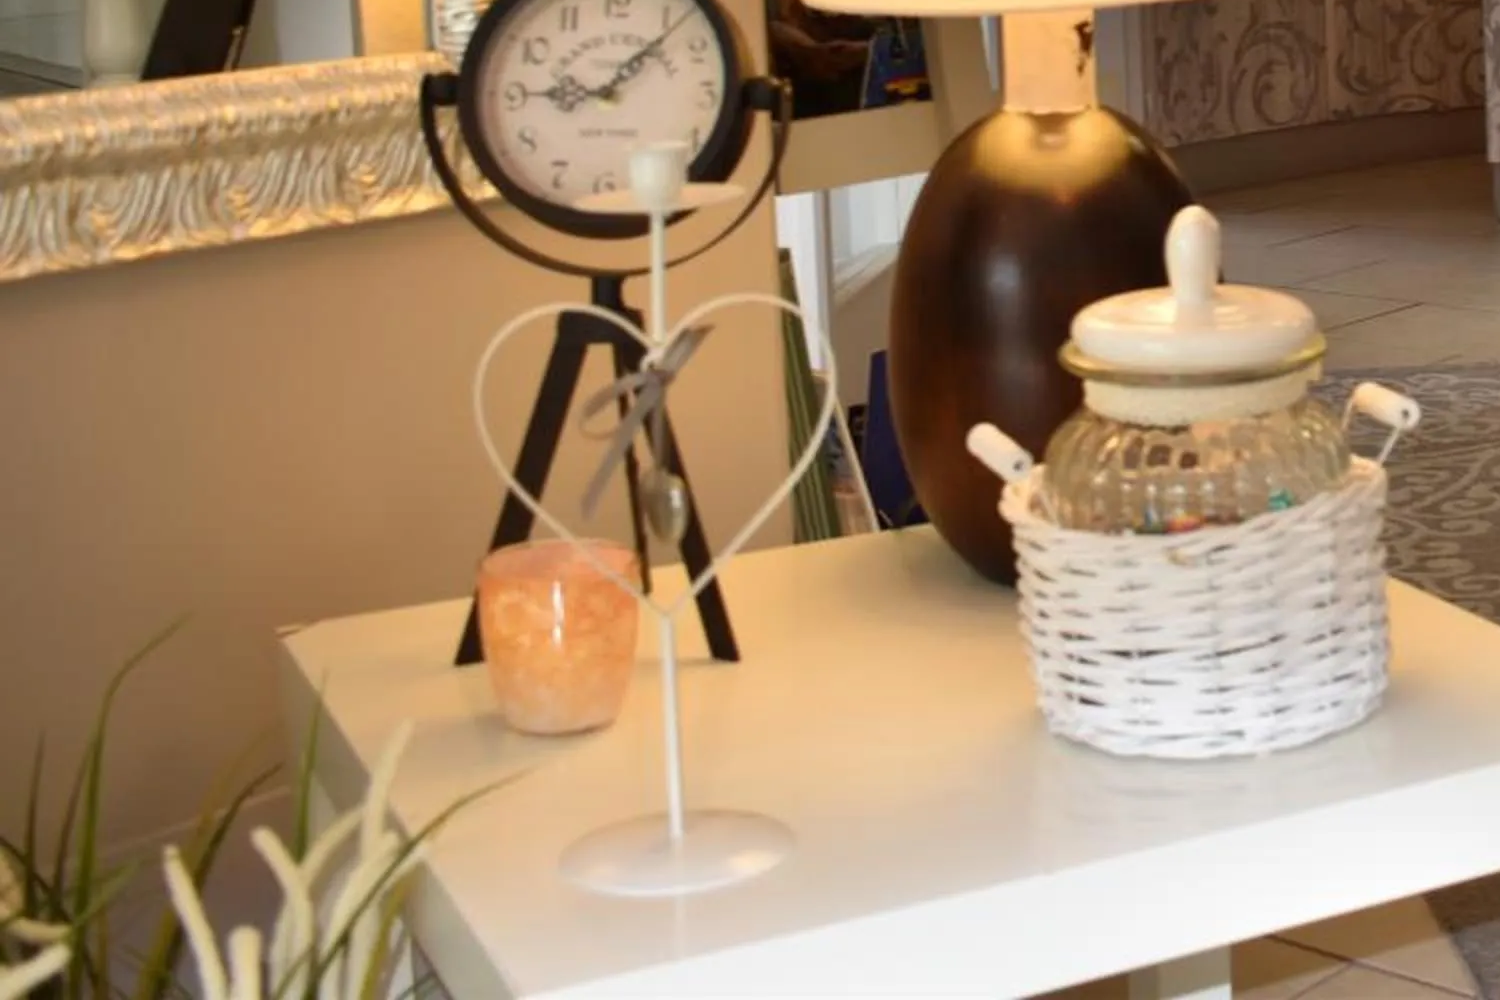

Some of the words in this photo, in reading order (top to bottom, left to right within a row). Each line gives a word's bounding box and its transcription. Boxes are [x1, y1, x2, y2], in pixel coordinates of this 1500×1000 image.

[560, 5, 578, 31] 11
[662, 5, 671, 28] 1
[521, 37, 550, 65] 10
[688, 37, 708, 64] 2
[504, 81, 528, 111] 9
[700, 80, 718, 110] 3
[517, 126, 537, 152] 8
[551, 160, 569, 189] 7
